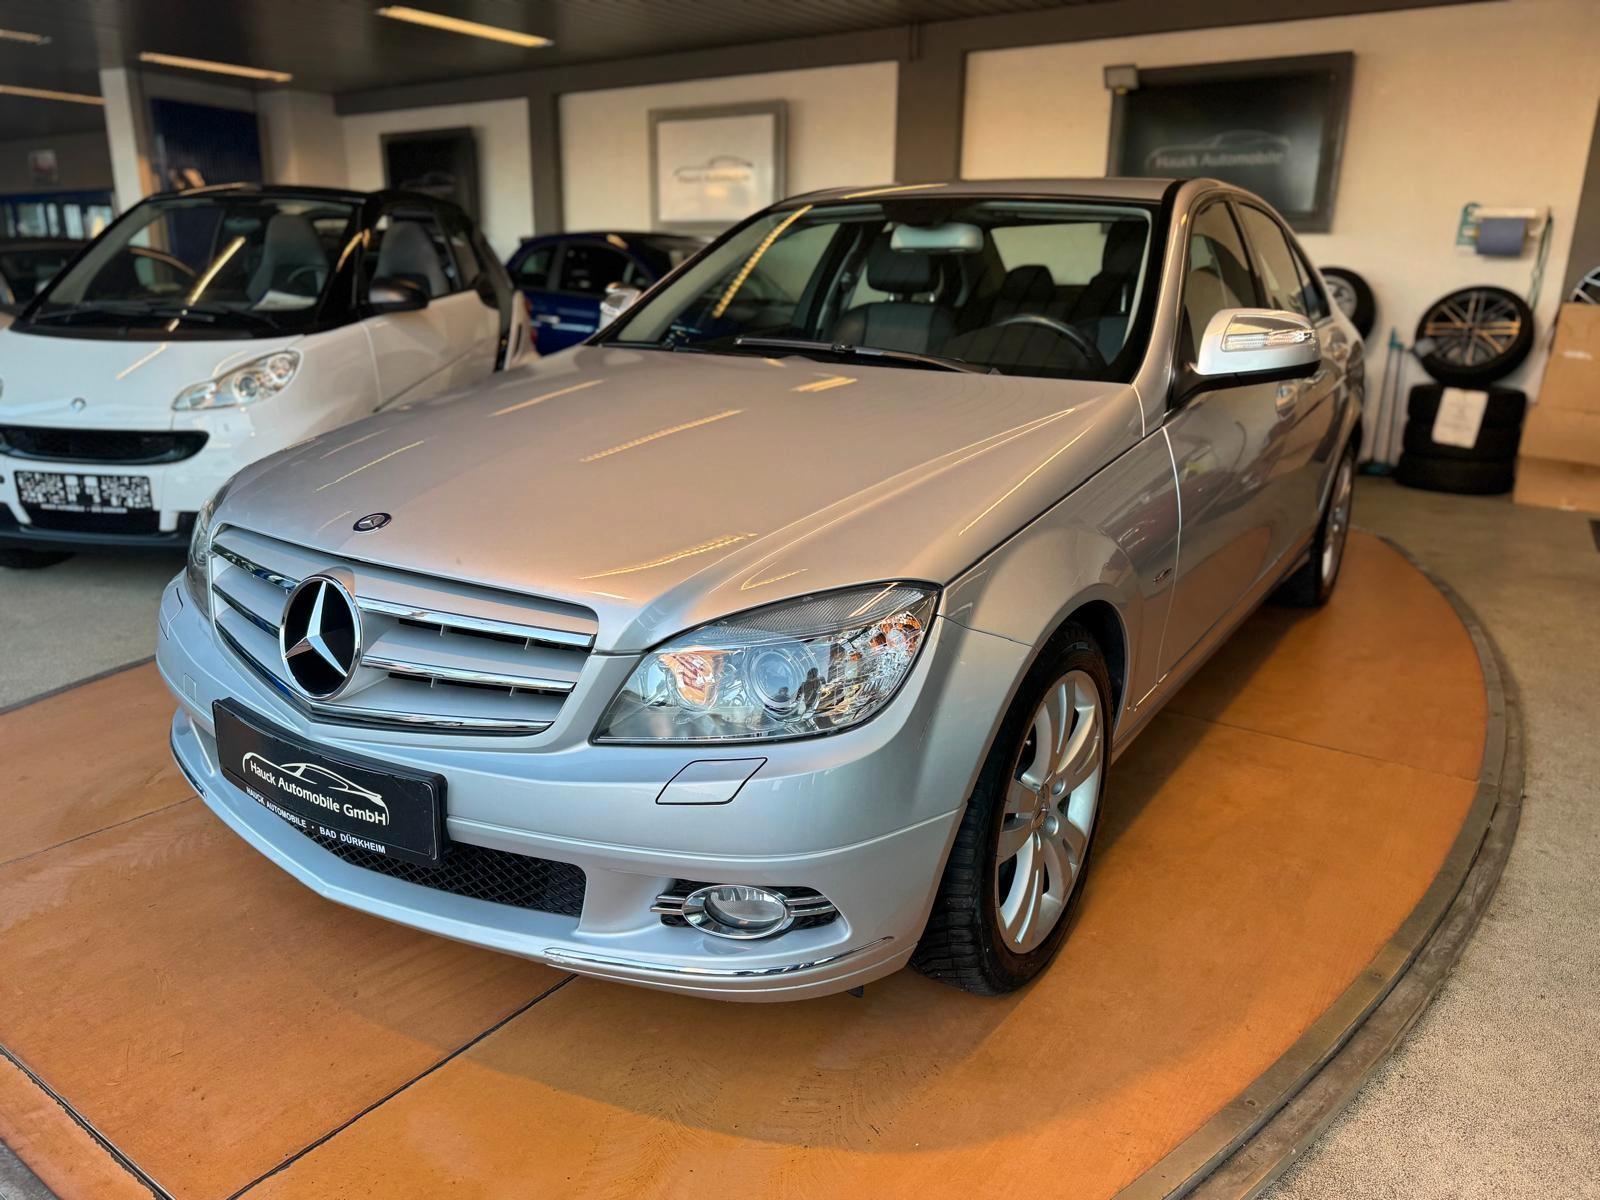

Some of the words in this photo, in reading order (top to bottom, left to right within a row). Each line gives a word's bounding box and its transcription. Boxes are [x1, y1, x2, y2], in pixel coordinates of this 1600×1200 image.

[245, 787, 265, 804] HAUCK
[266, 802, 307, 828] AUTOMOBILE
[319, 827, 337, 839] BAD
[340, 833, 386, 854] DÜRKHEIM
[250, 760, 276, 785] Hauck
[278, 777, 340, 812] Automobile
[343, 804, 386, 825] GmbH
